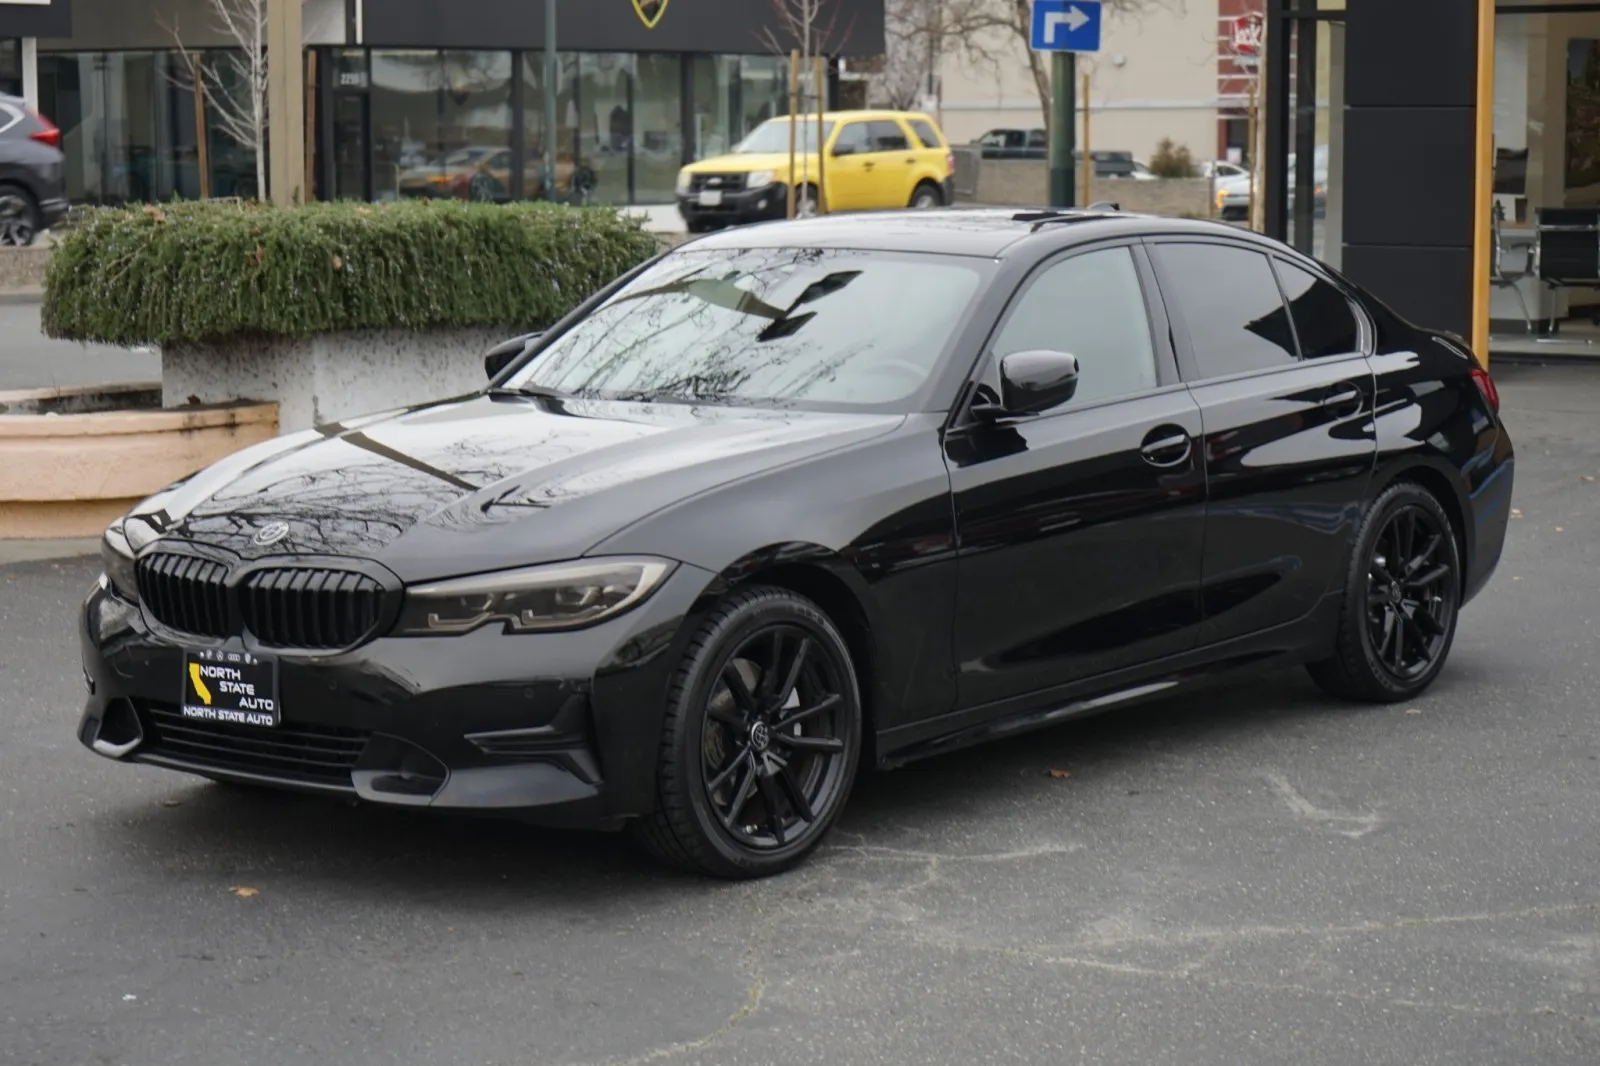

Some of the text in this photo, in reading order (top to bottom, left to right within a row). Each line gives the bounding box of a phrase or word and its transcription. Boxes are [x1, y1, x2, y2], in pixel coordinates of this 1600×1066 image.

[200, 665, 241, 680] NORTH
[219, 681, 255, 696] STATE
[239, 697, 274, 710] AUTO
[183, 706, 273, 726] NORTH STATE AUTO
